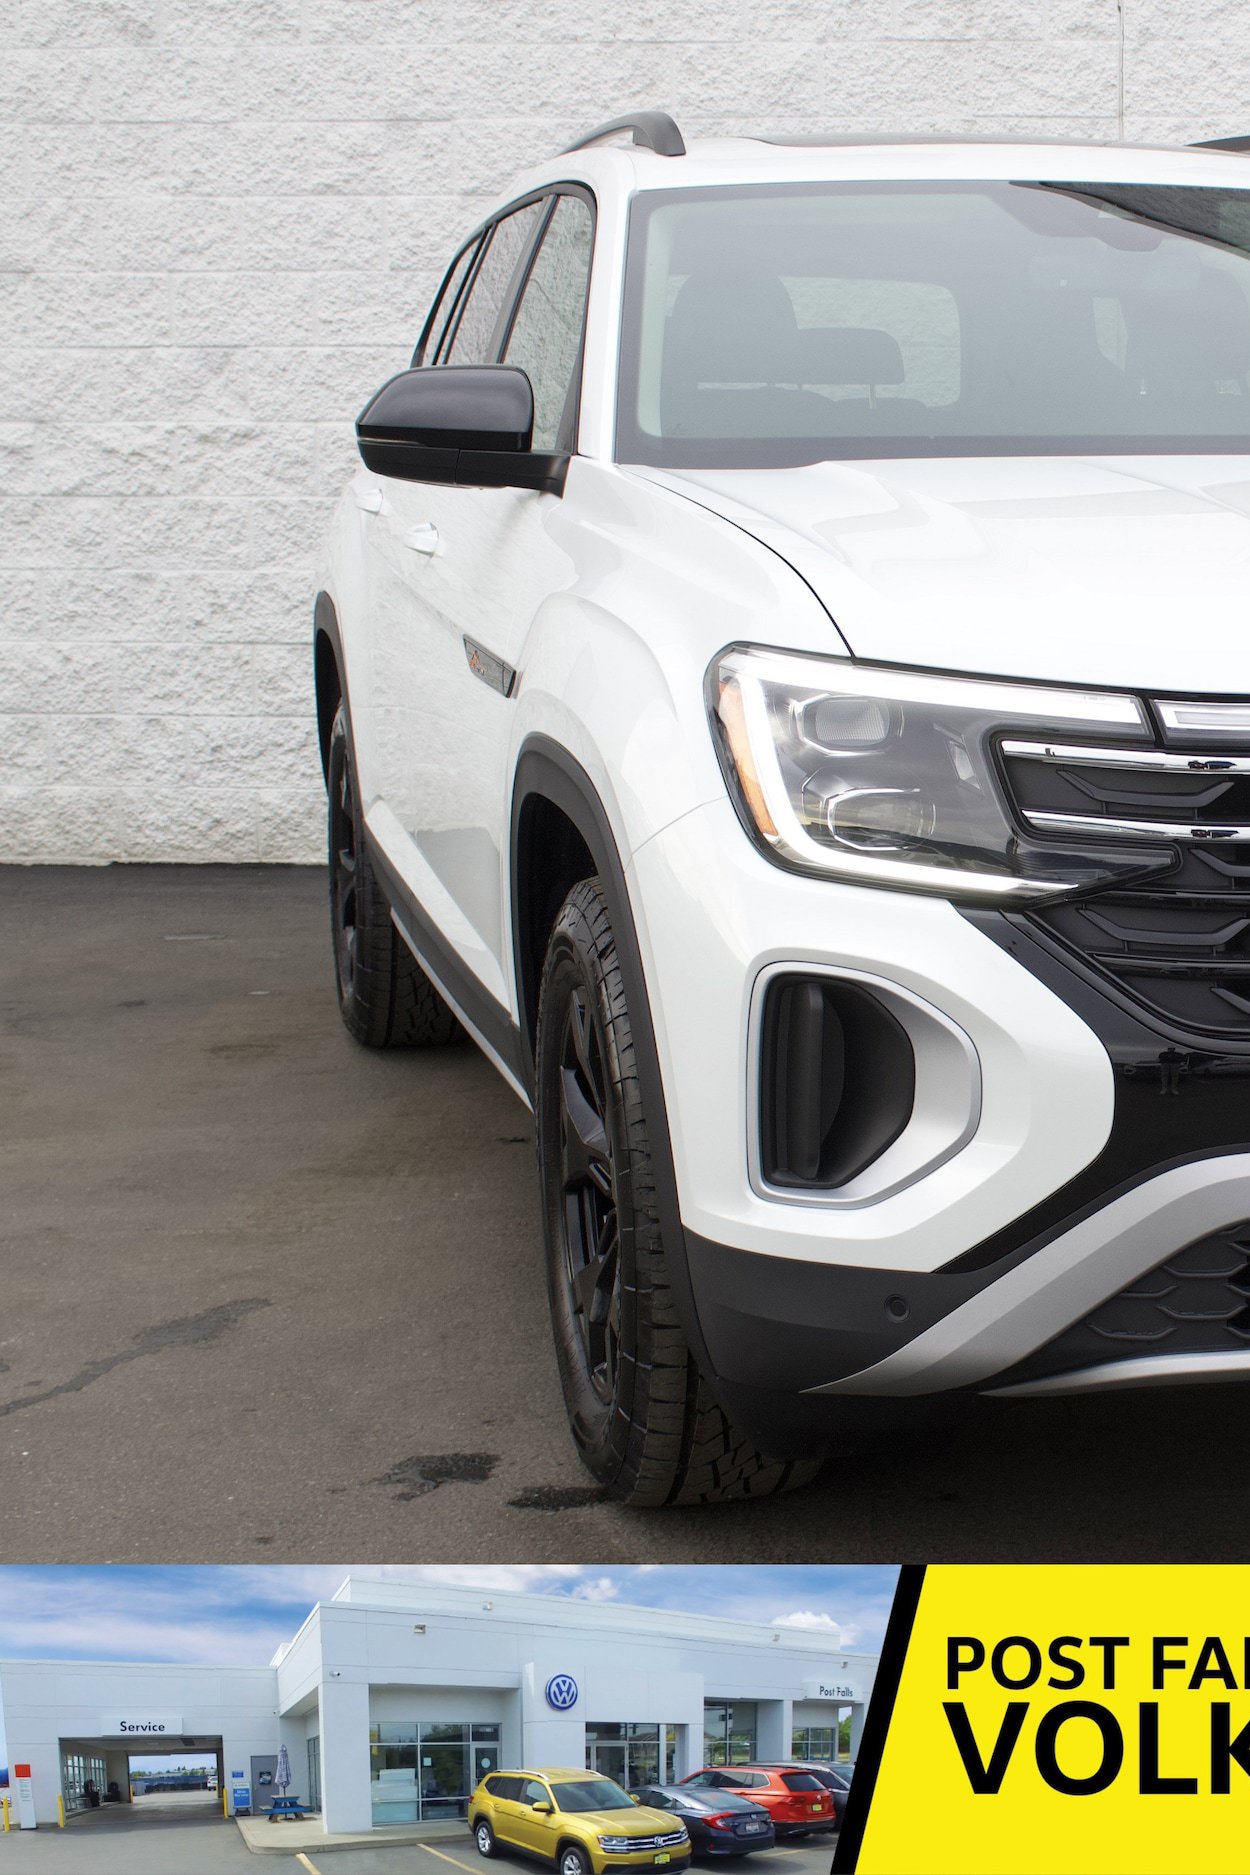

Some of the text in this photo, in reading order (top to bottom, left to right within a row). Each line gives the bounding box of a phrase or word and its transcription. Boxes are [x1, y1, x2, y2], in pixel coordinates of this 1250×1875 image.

[549, 1676, 576, 1708] VW
[819, 1685, 854, 1697] Post Falls
[119, 1720, 166, 1732] Service
